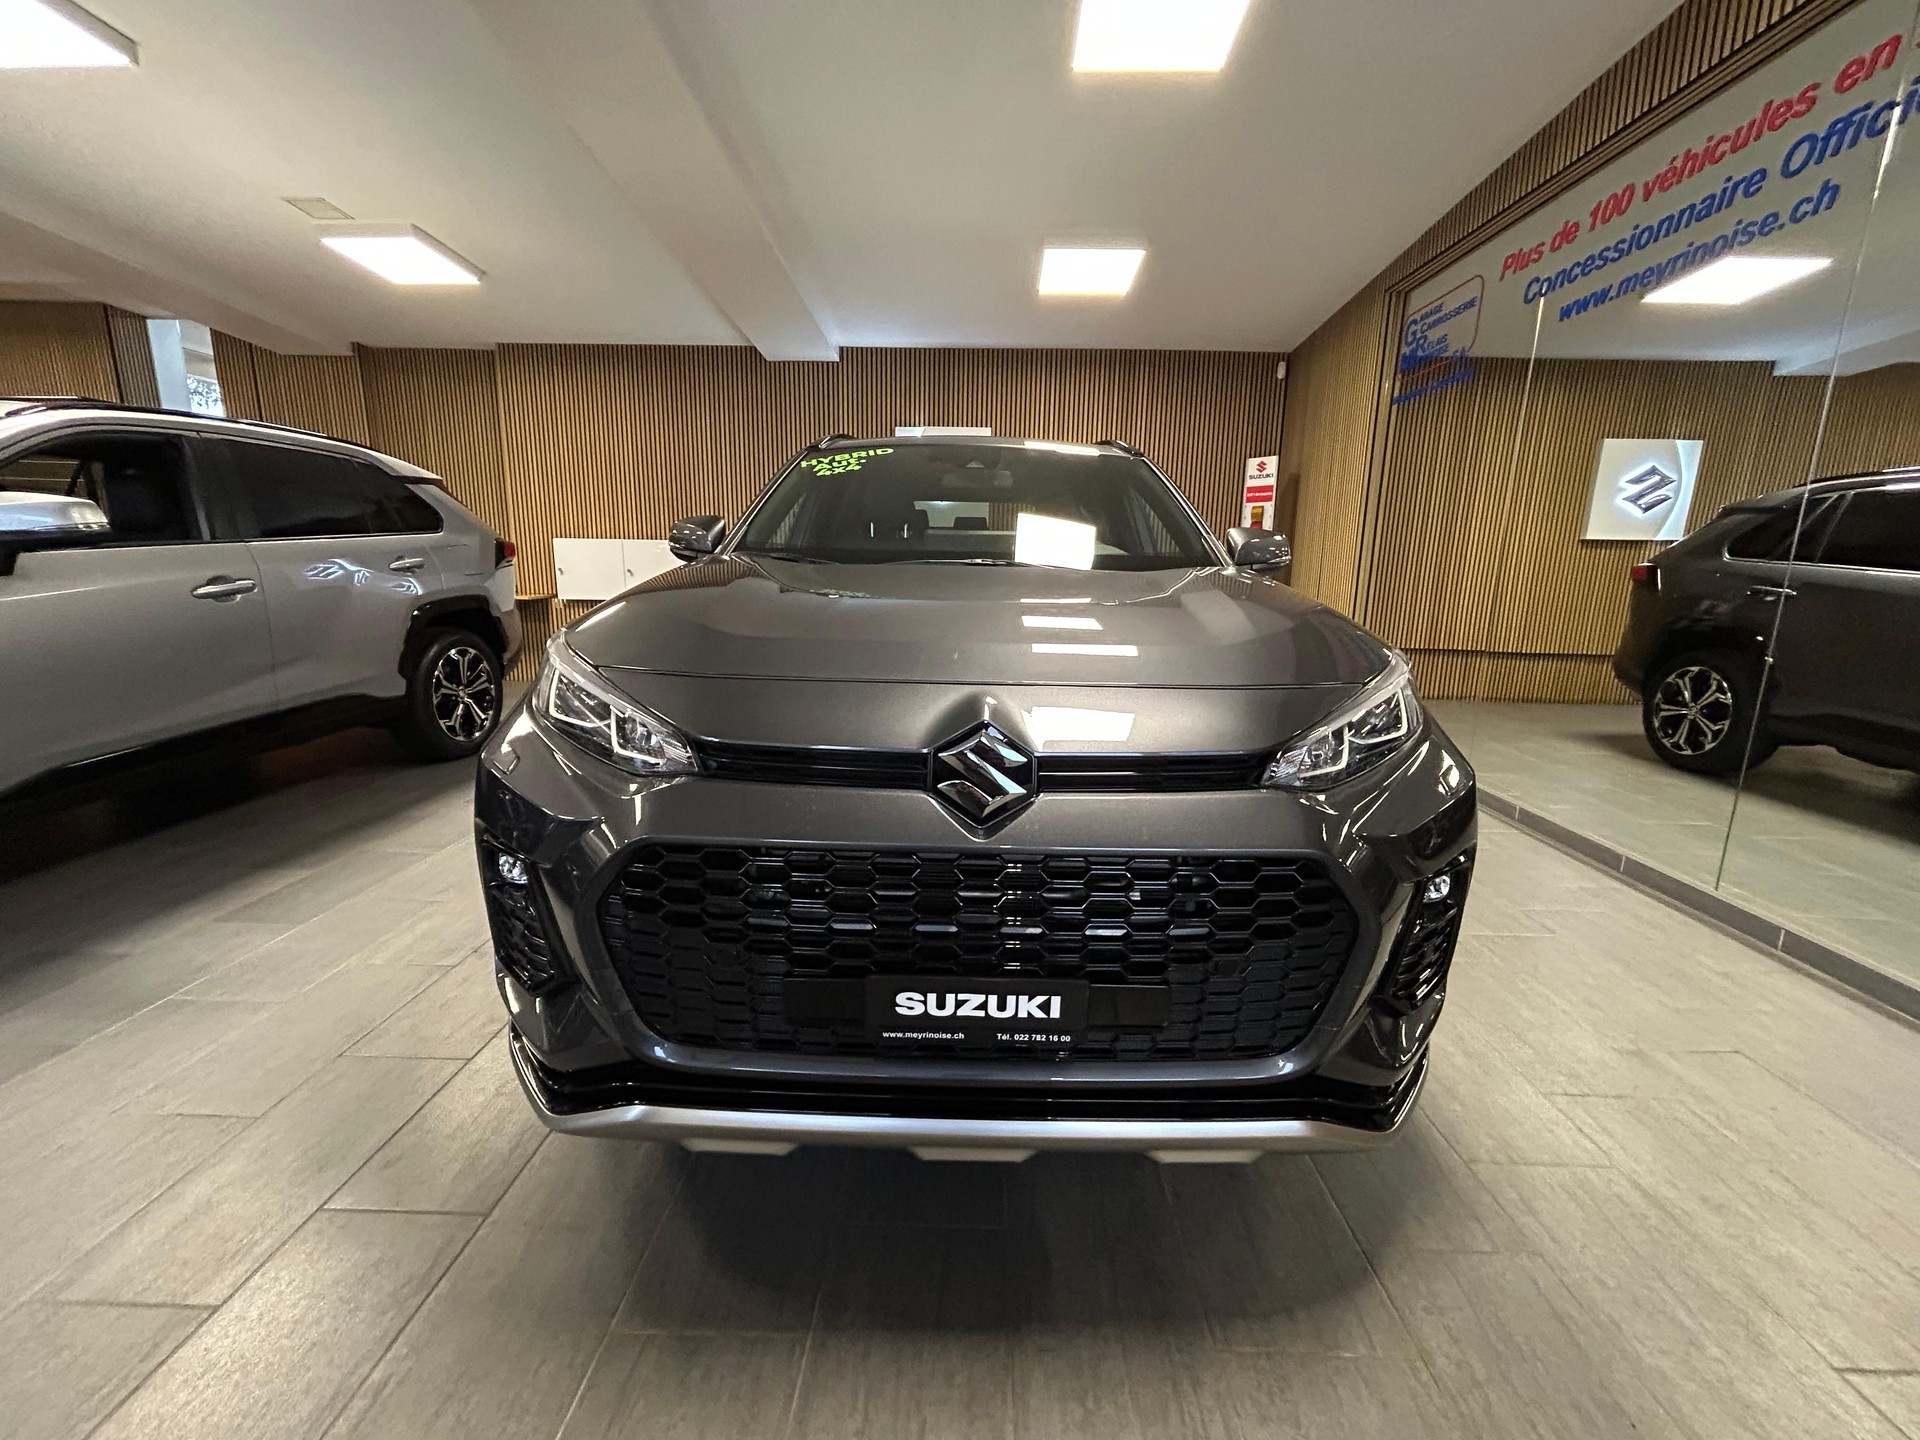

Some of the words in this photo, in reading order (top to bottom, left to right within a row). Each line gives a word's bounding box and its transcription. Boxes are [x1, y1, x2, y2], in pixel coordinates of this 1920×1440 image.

[1500, 244, 1545, 281] Plus
[1549, 220, 1579, 254] de
[1590, 183, 1636, 233] 100
[1641, 81, 1821, 203] véhicules
[1833, 33, 1903, 94] en
[1523, 168, 1767, 304] Concessionnaire
[1780, 74, 1920, 179] Offici
[801, 448, 894, 468] HYBRID
[895, 991, 1061, 1019] SUZUKI
[882, 1031, 965, 1041] www.meyrinoise.ch
[996, 1033, 1012, 1041] Tél.
[1014, 1034, 1029, 1042] 022
[1031, 1034, 1046, 1042] 782
[1048, 1034, 1059, 1042] 16
[1060, 1034, 1071, 1043] 00
